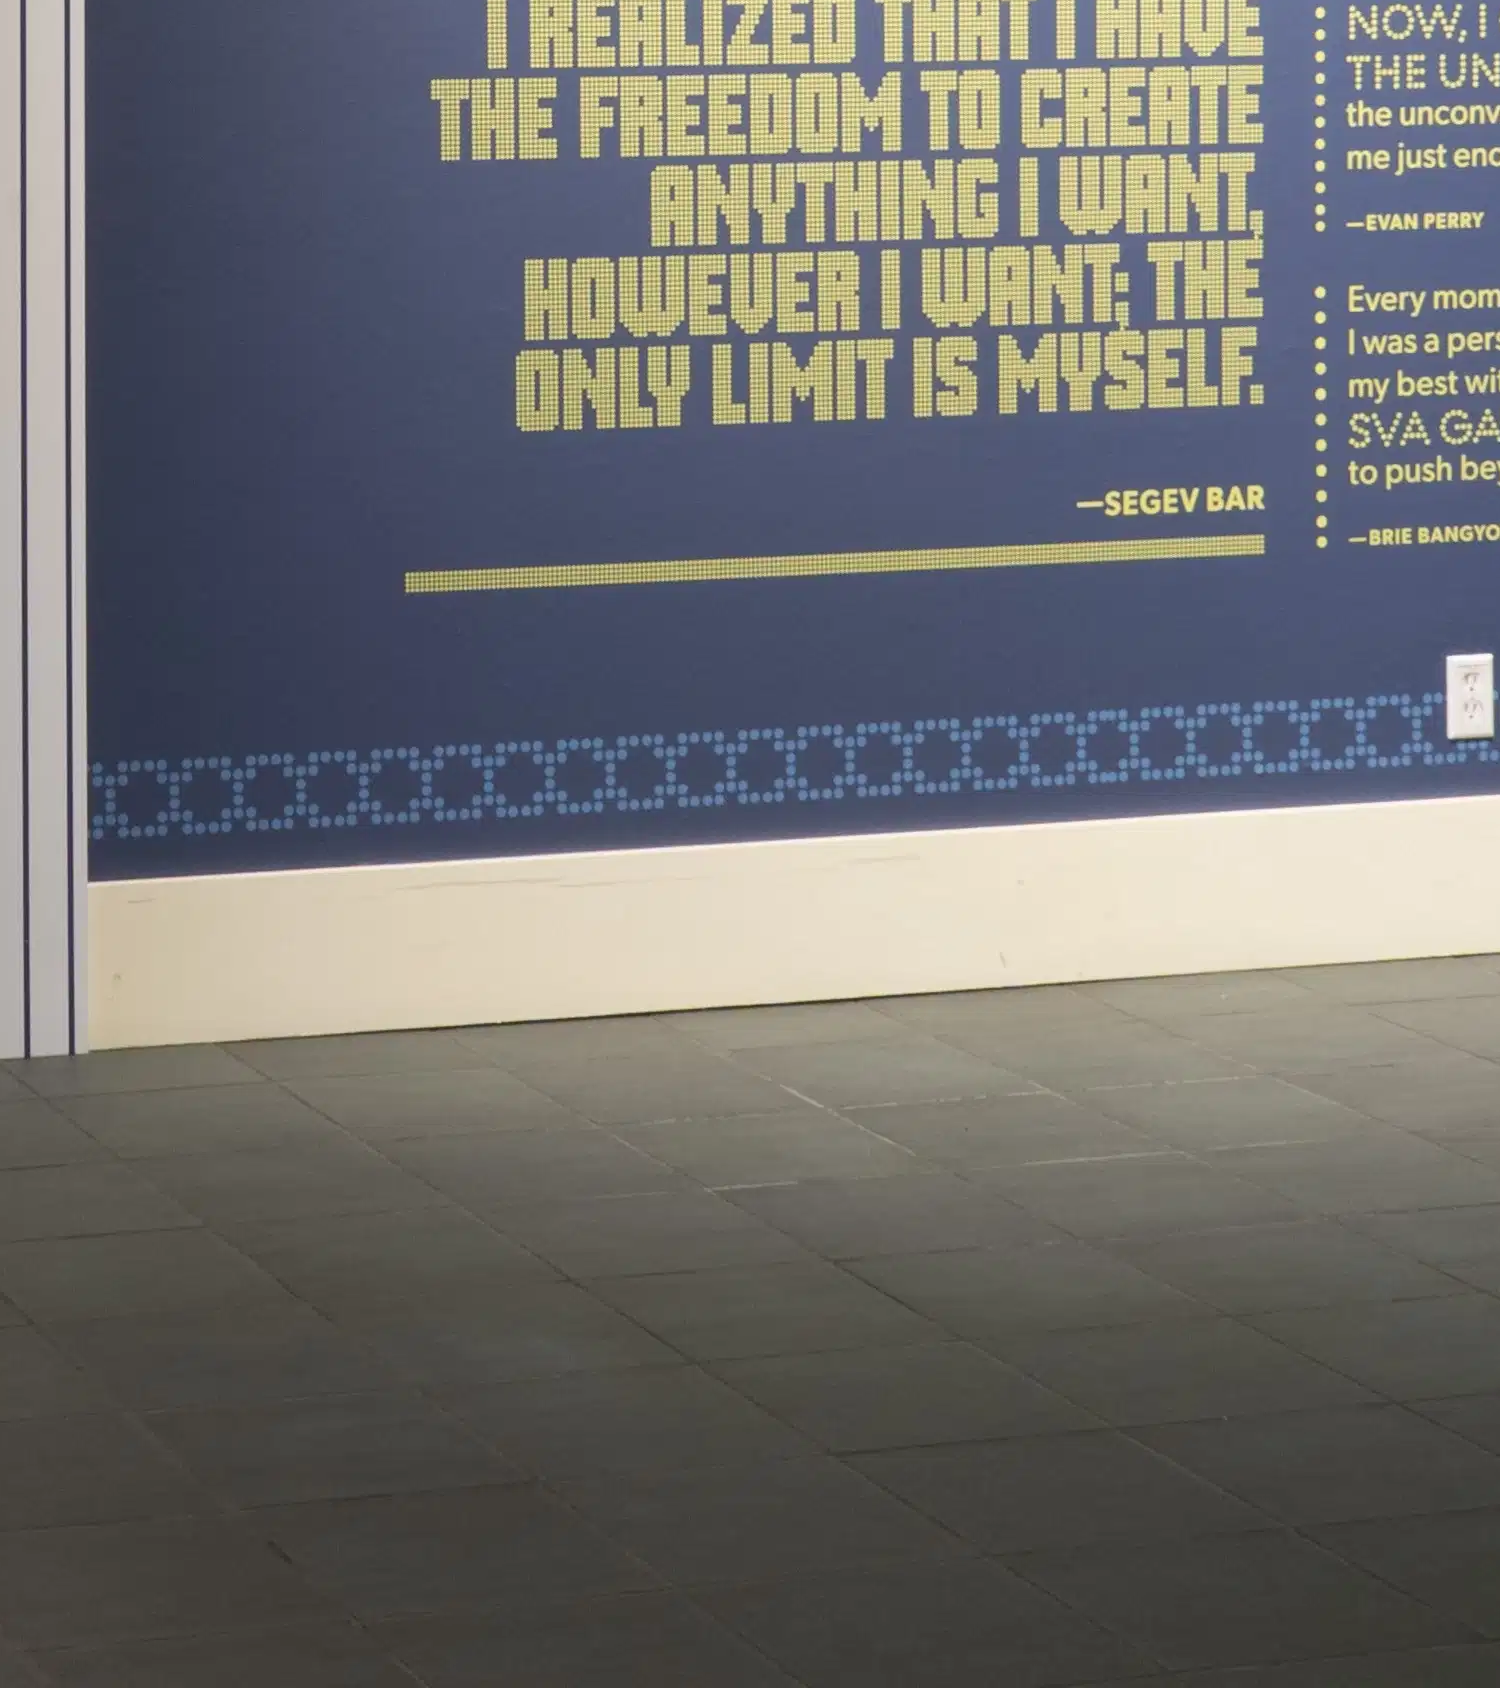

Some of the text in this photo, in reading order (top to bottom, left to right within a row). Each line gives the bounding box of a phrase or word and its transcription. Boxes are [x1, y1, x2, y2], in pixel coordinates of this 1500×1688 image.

[1347, 2, 1468, 43] NOW,
[1478, 3, 1489, 41] I
[1344, 52, 1427, 90] THE
[430, 63, 1265, 162] THE FREEDOM TO CREATE
[1345, 100, 1394, 128] the
[1345, 149, 1392, 171] me
[1395, 143, 1447, 177] just
[649, 151, 1265, 249] ANYTHING I WANT,
[1421, 211, 1485, 231] PERRY
[524, 238, 1265, 342] HOWEVER I WANT; THE
[515, 326, 1265, 433] ONLY LIMIT IS MYSELF.
[1205, 484, 1266, 513] BAR
